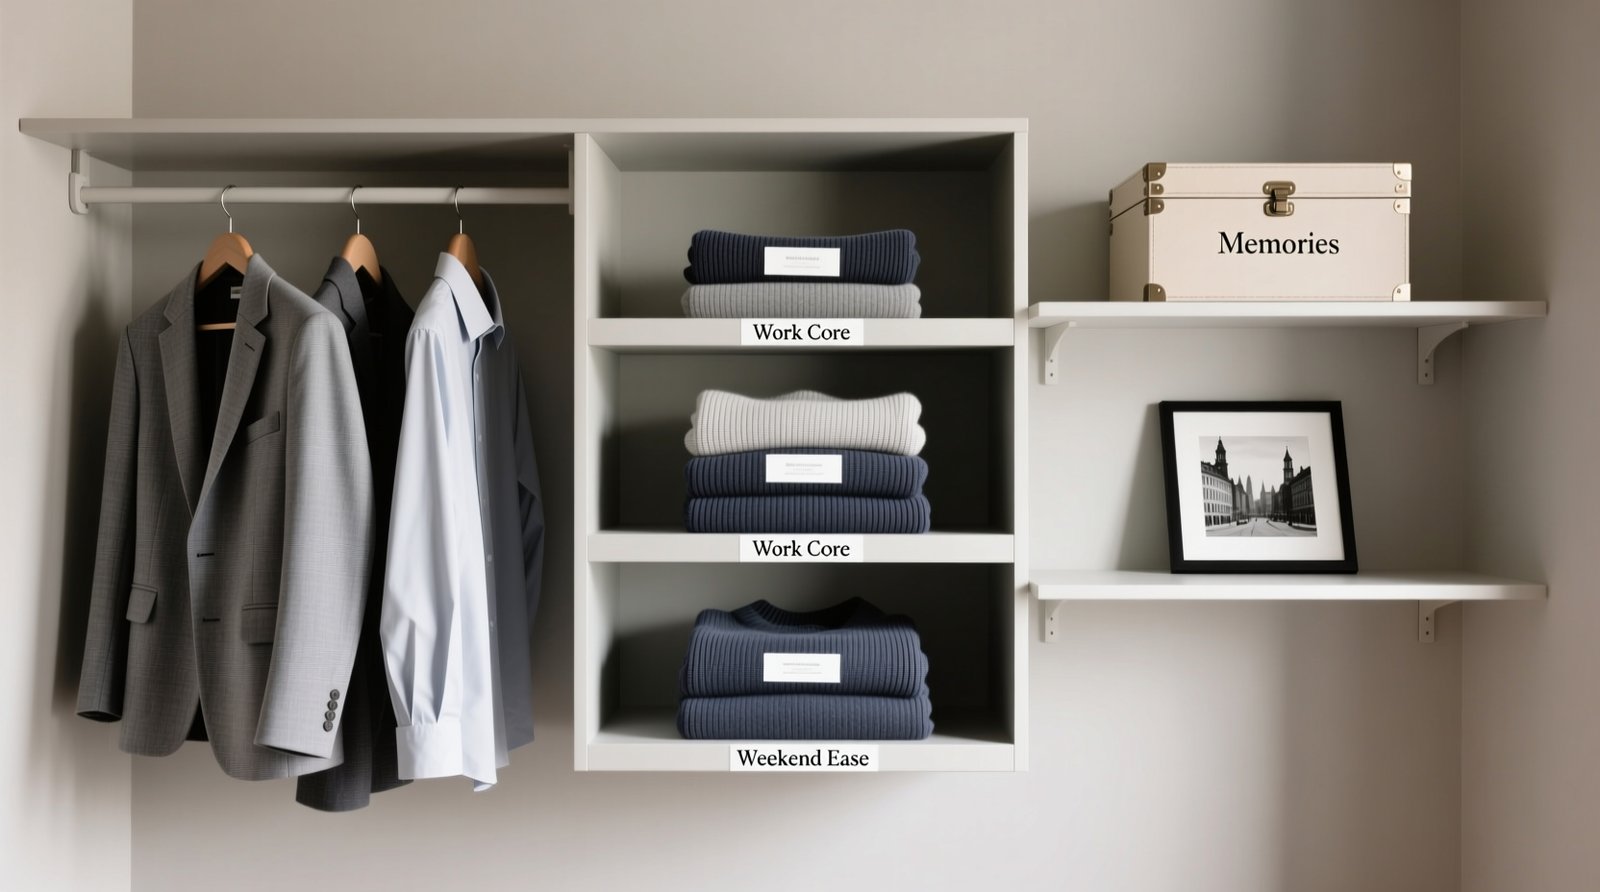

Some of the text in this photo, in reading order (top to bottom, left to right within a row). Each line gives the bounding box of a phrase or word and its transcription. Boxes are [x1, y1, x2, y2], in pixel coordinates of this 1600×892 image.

[1218, 231, 1340, 255] Memories
[753, 323, 851, 341] Work Core
[752, 539, 850, 557] Work Core
[737, 749, 869, 767] Weekend Ease
